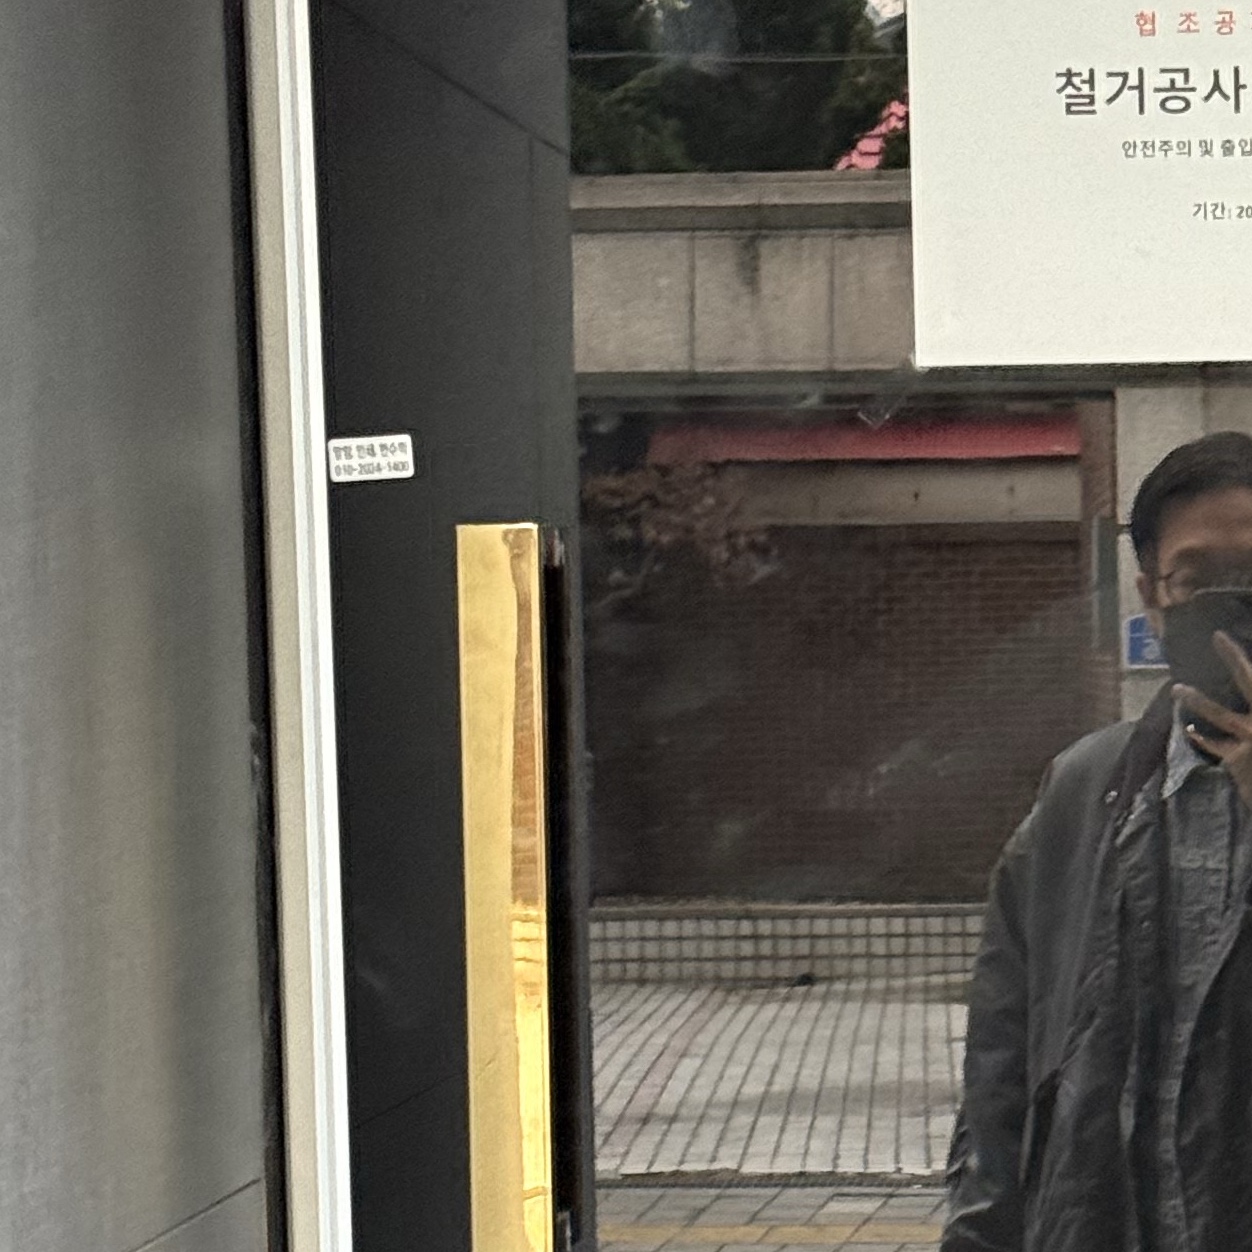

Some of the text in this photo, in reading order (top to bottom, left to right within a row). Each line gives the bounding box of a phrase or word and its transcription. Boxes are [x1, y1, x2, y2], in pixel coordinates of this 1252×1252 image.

[1055, 65, 1248, 116] 철거공사
[1121, 139, 1192, 158] 안전주의
[1198, 138, 1214, 158] 및
